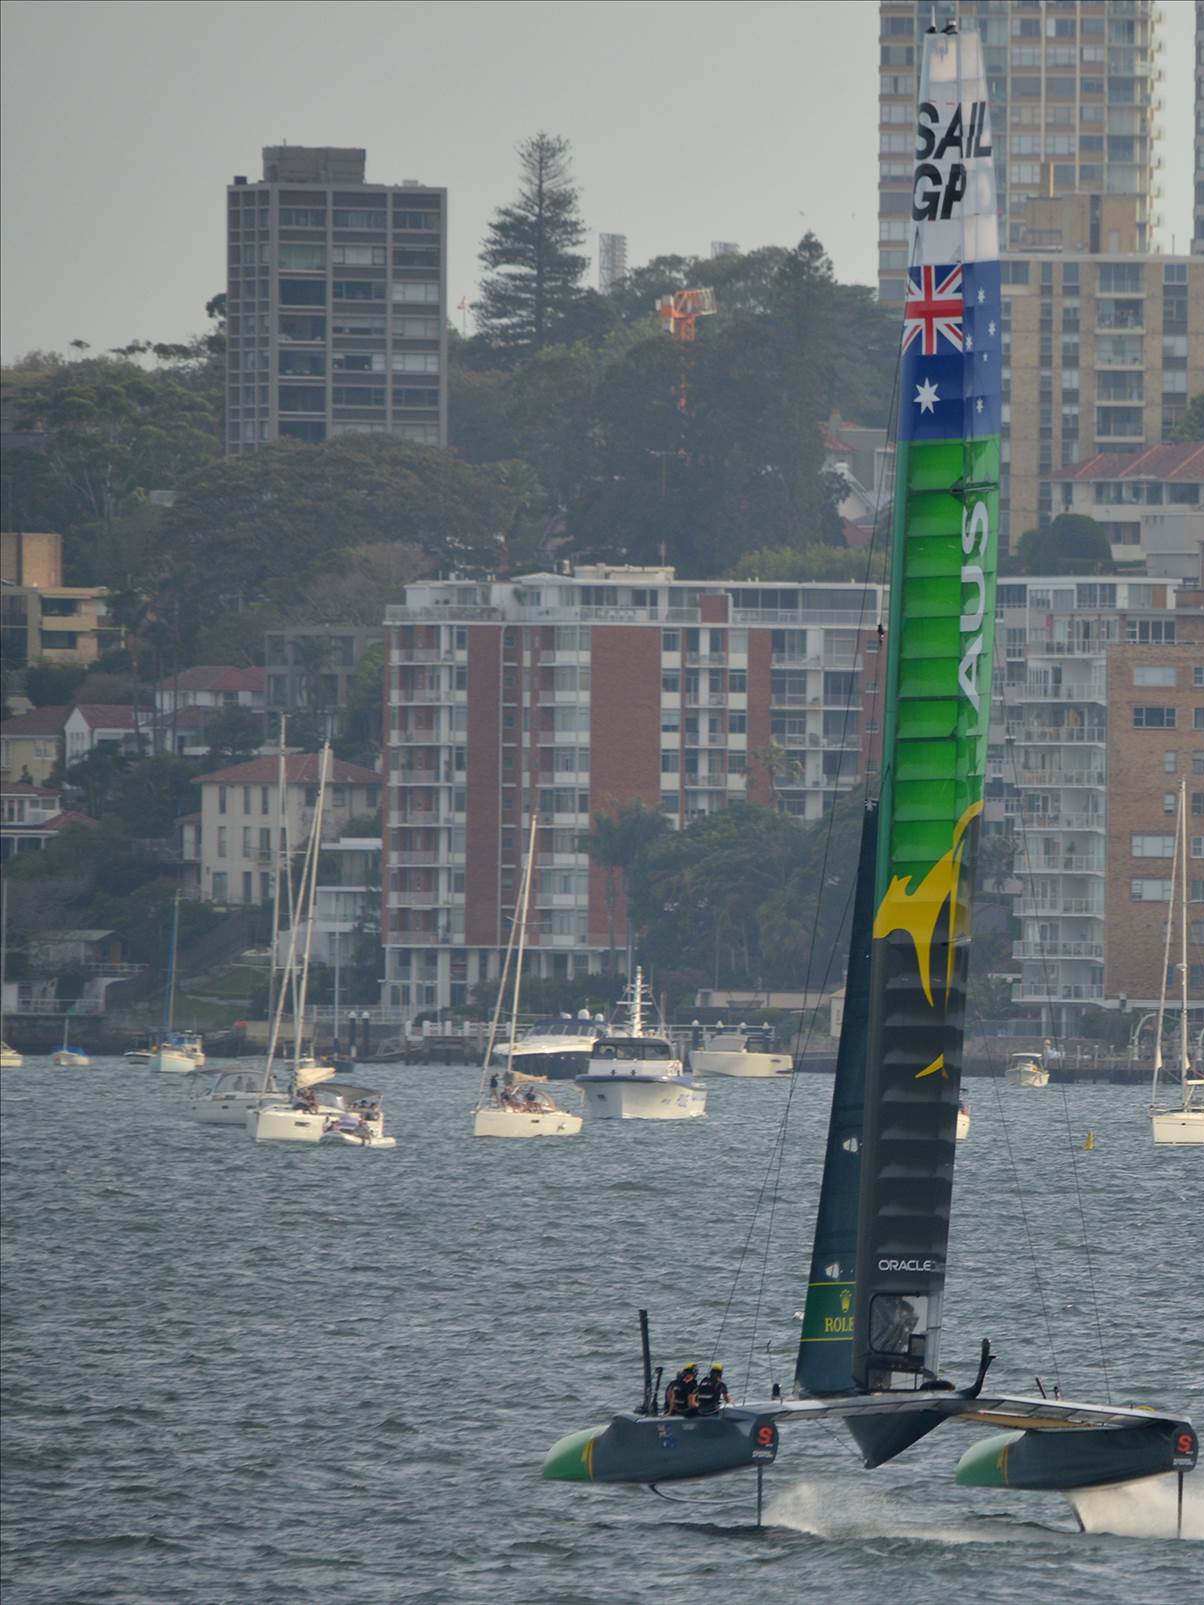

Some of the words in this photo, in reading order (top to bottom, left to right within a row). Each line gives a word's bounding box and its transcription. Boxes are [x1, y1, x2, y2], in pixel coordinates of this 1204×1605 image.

[916, 101, 992, 160] SAIL
[912, 163, 967, 221] GP
[958, 501, 989, 713] AUS
[878, 1259, 932, 1272] ORACLE
[1177, 1434, 1192, 1452] S
